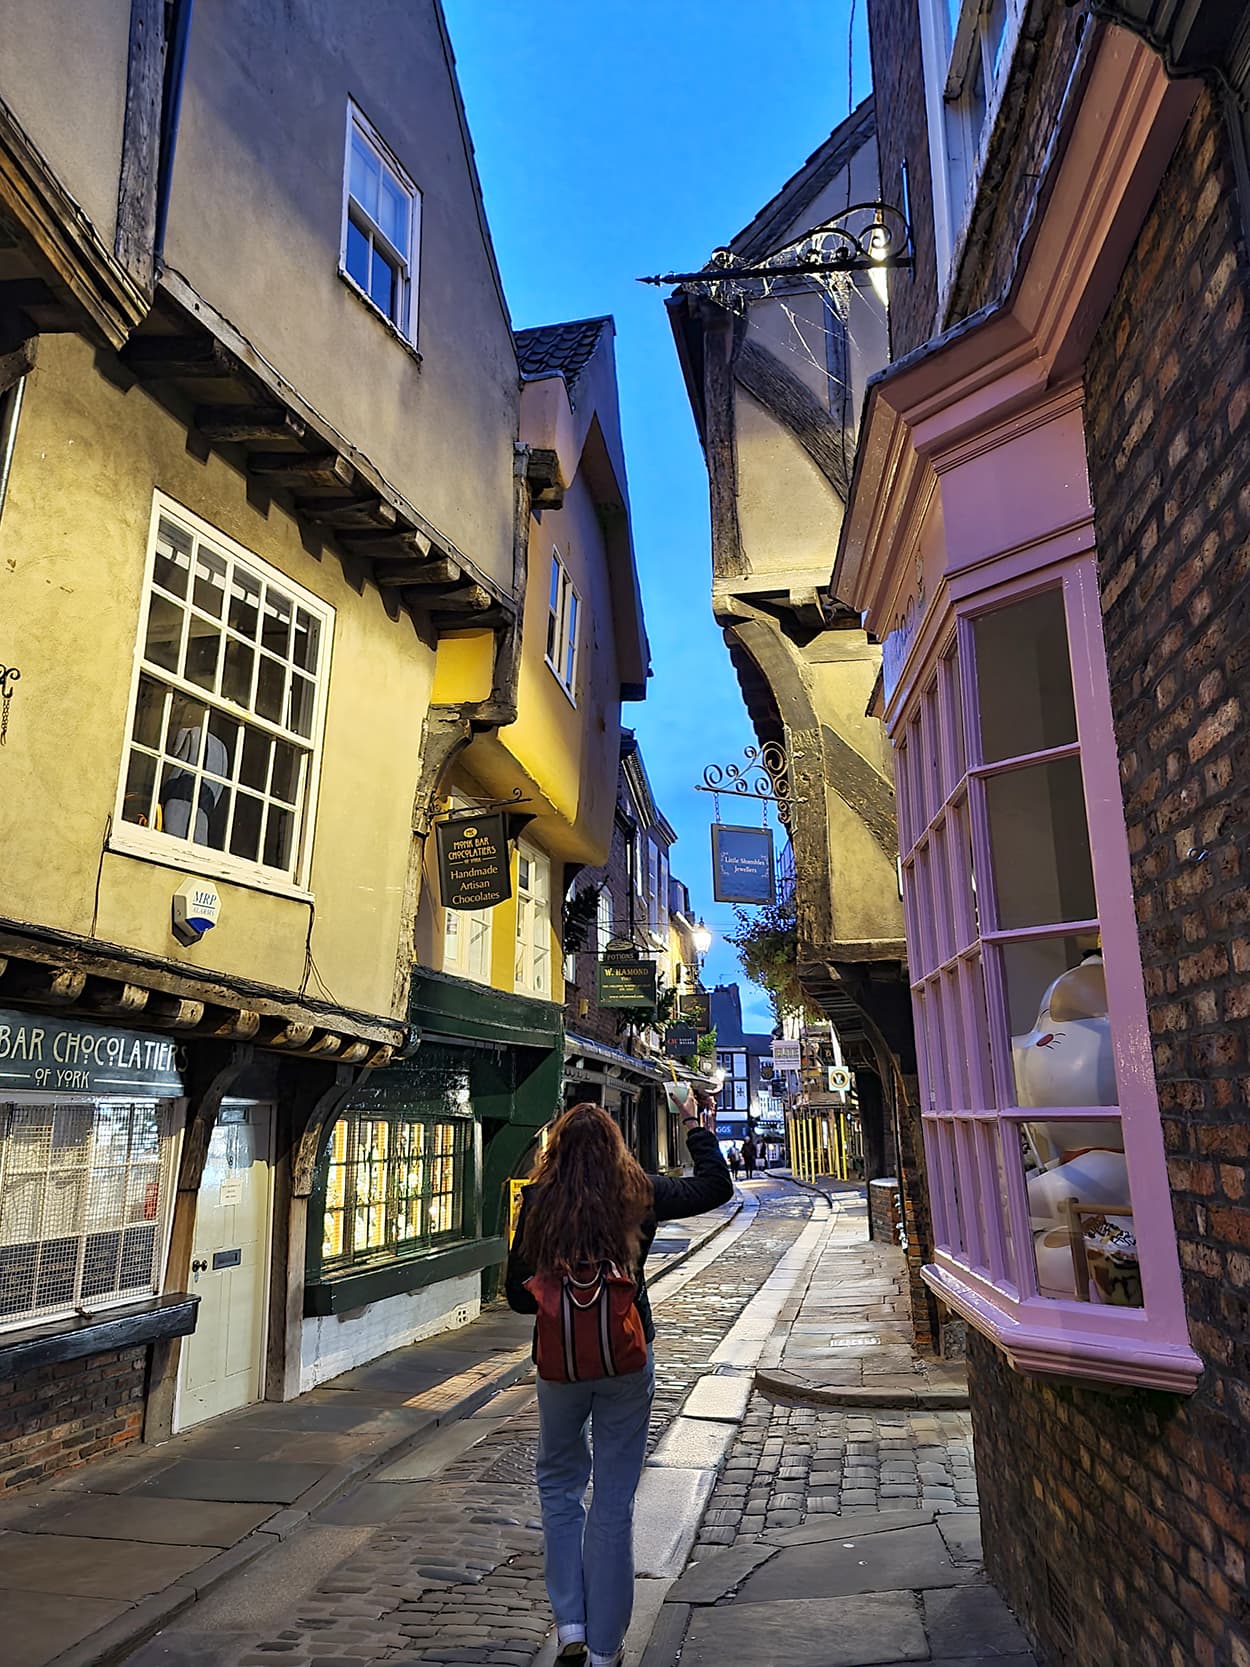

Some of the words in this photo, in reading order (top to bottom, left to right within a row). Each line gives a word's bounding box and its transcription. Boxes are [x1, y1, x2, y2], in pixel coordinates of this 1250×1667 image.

[453, 839, 474, 850] MONK
[475, 837, 490, 847] BAR
[448, 845, 497, 860] CHOCOLATIERS
[450, 865, 499, 880] Handmade
[460, 880, 490, 891] Artisan
[192, 891, 217, 905] MRP
[452, 892, 501, 905] Chocolates
[0, 1024, 46, 1061] BAR
[53, 1031, 189, 1072] CHOCOLATIERS
[35, 1068, 51, 1086] OF
[56, 1069, 90, 1088] YORK
